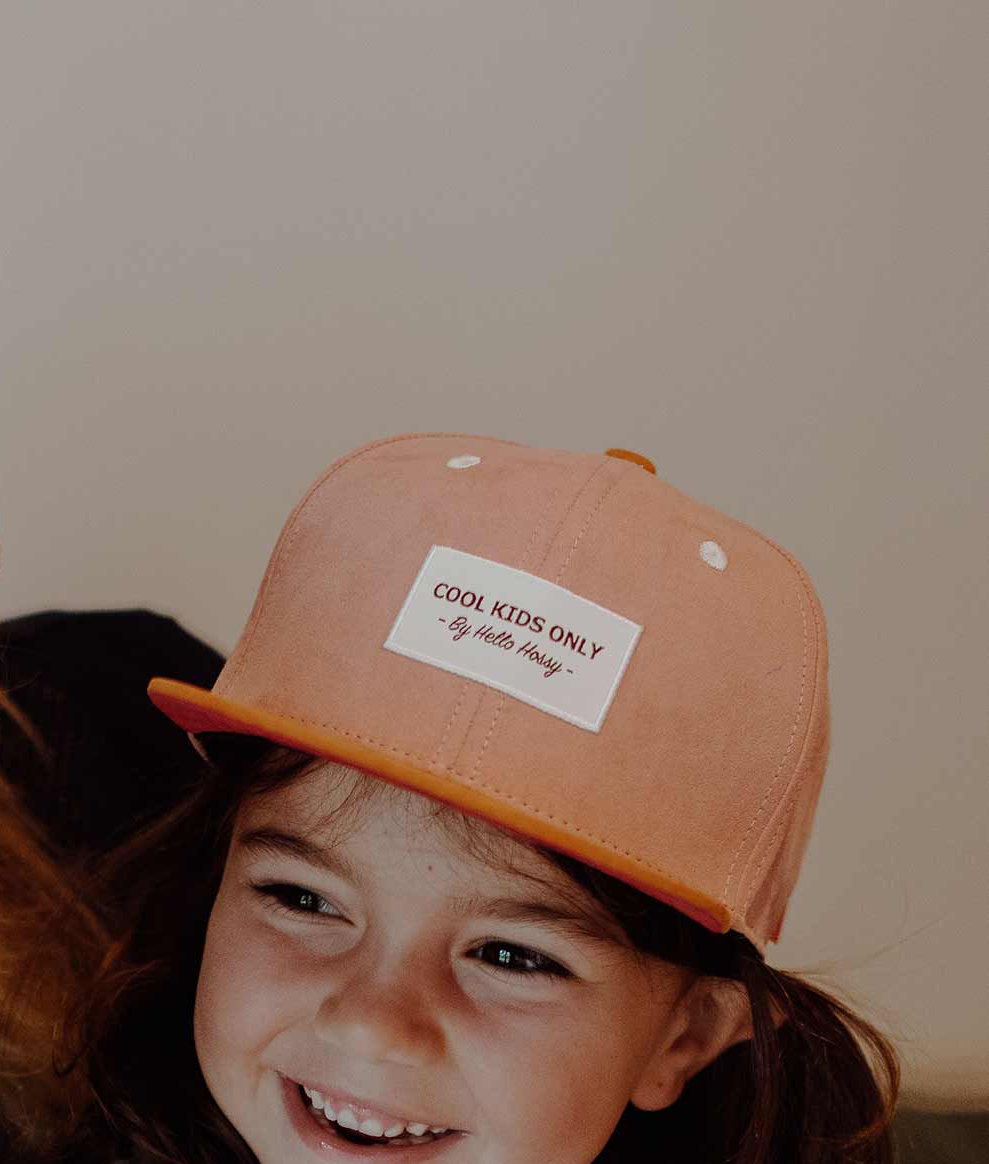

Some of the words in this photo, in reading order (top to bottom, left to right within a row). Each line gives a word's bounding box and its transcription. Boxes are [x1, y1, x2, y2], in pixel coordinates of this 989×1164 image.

[433, 582, 485, 613] COOL
[490, 600, 546, 633] KIDS
[549, 625, 605, 661] ONLY
[448, 616, 473, 642] By
[473, 624, 516, 651] Hello
[516, 641, 563, 679] Hossy
